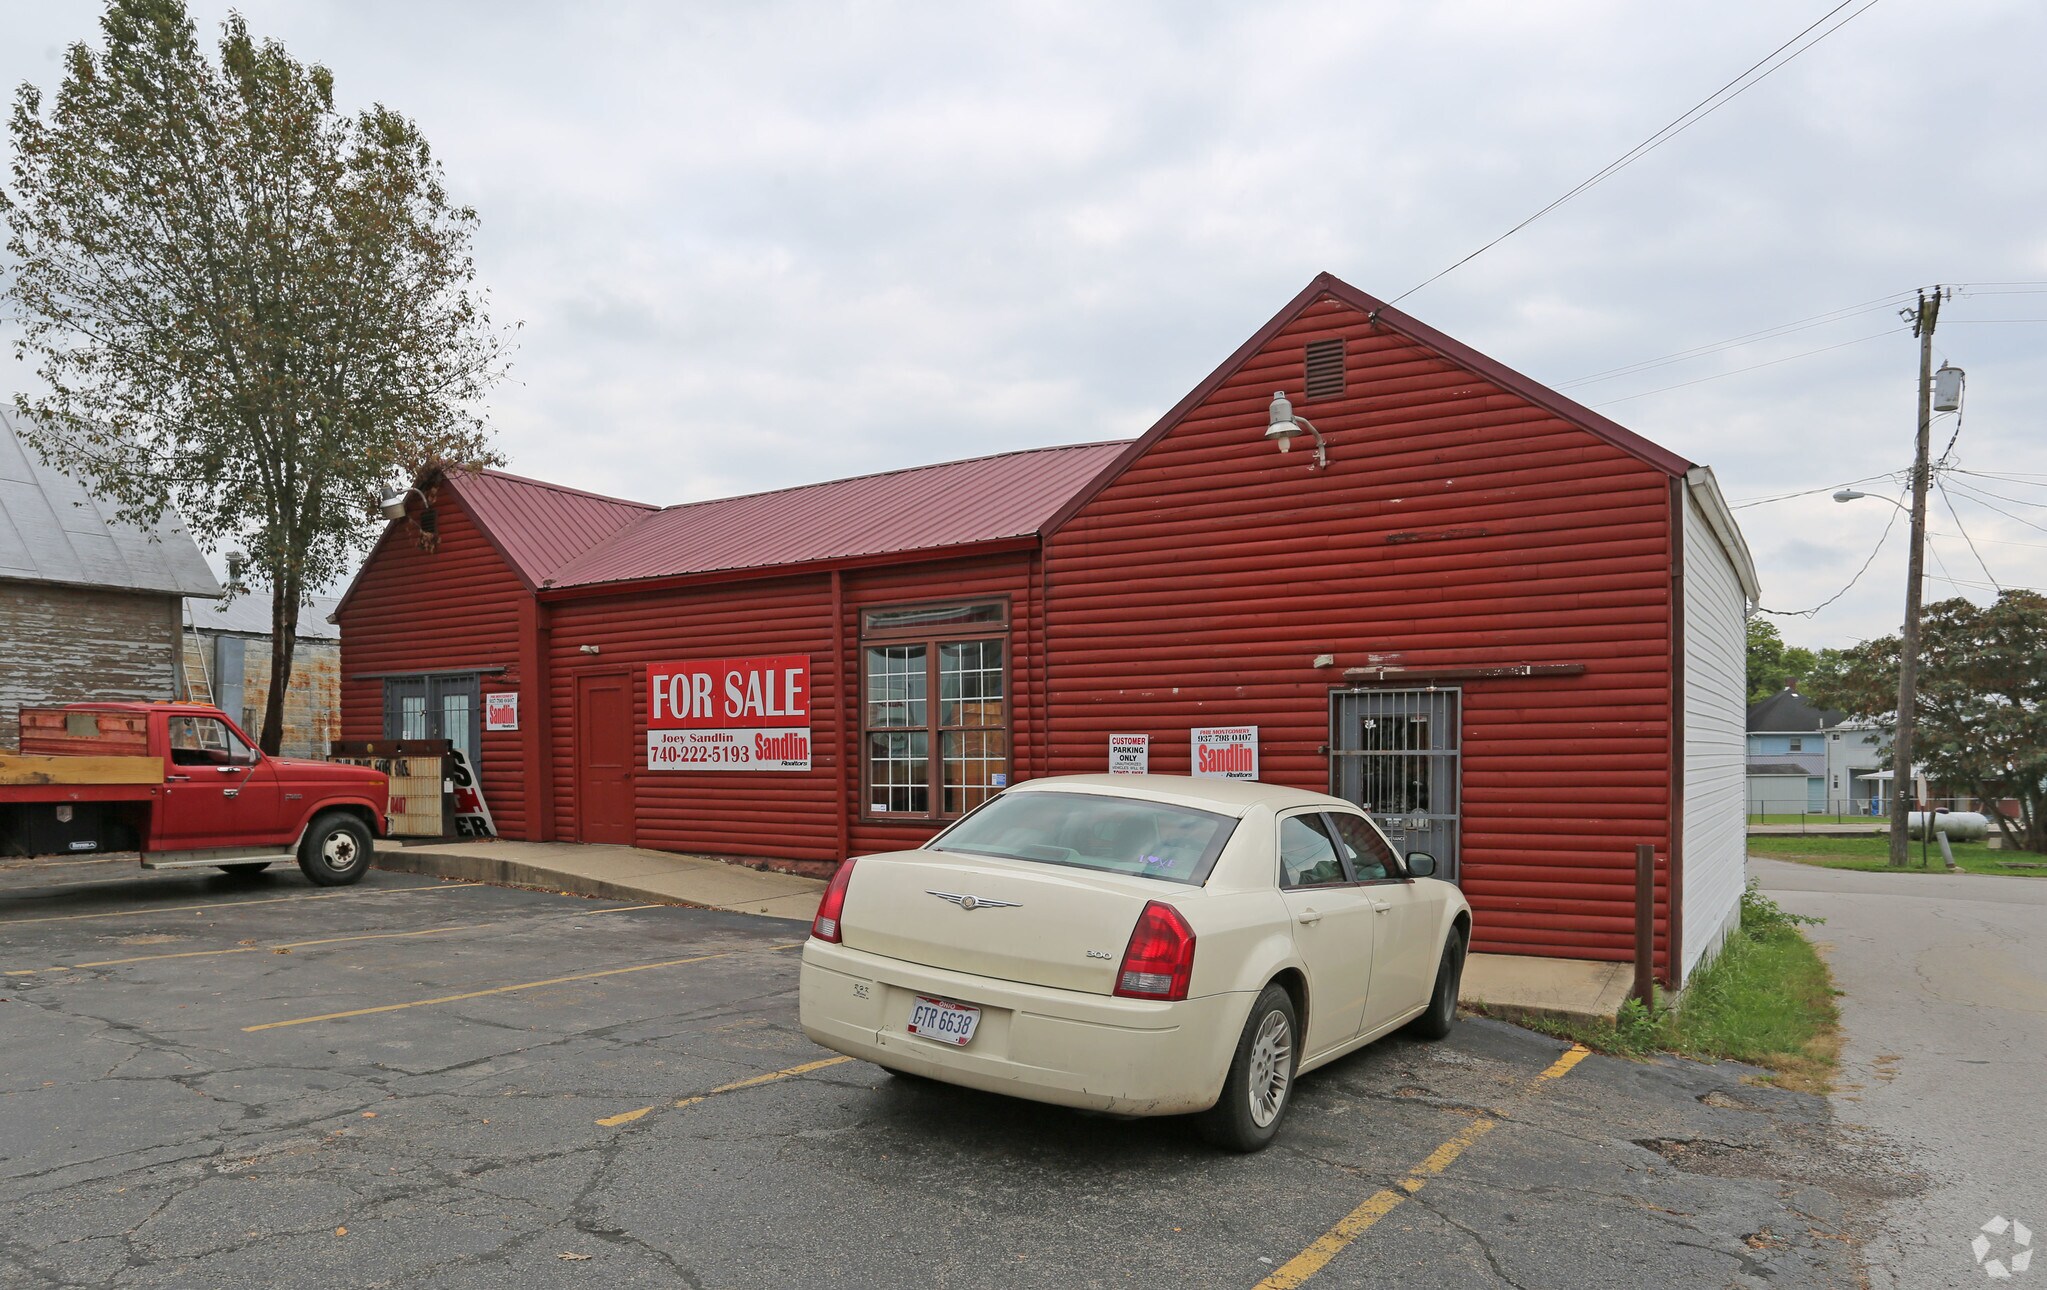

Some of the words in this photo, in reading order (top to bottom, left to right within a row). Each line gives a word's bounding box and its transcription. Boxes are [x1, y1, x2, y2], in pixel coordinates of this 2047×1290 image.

[652, 672, 713, 719] FOR
[724, 668, 805, 718] SALE
[661, 733, 686, 744] Joey
[689, 733, 734, 743] Sandlin
[1112, 737, 1146, 745] CUSTOMER
[755, 732, 808, 761] Sandlin
[1113, 746, 1144, 754] PARKING
[651, 745, 750, 763] 740-222-5193
[1199, 743, 1253, 773] Sandlin
[1086, 949, 1113, 960] 300
[938, 1001, 956, 1010] OHIO
[913, 1006, 938, 1029] GTR
[938, 1010, 972, 1035] 6638
